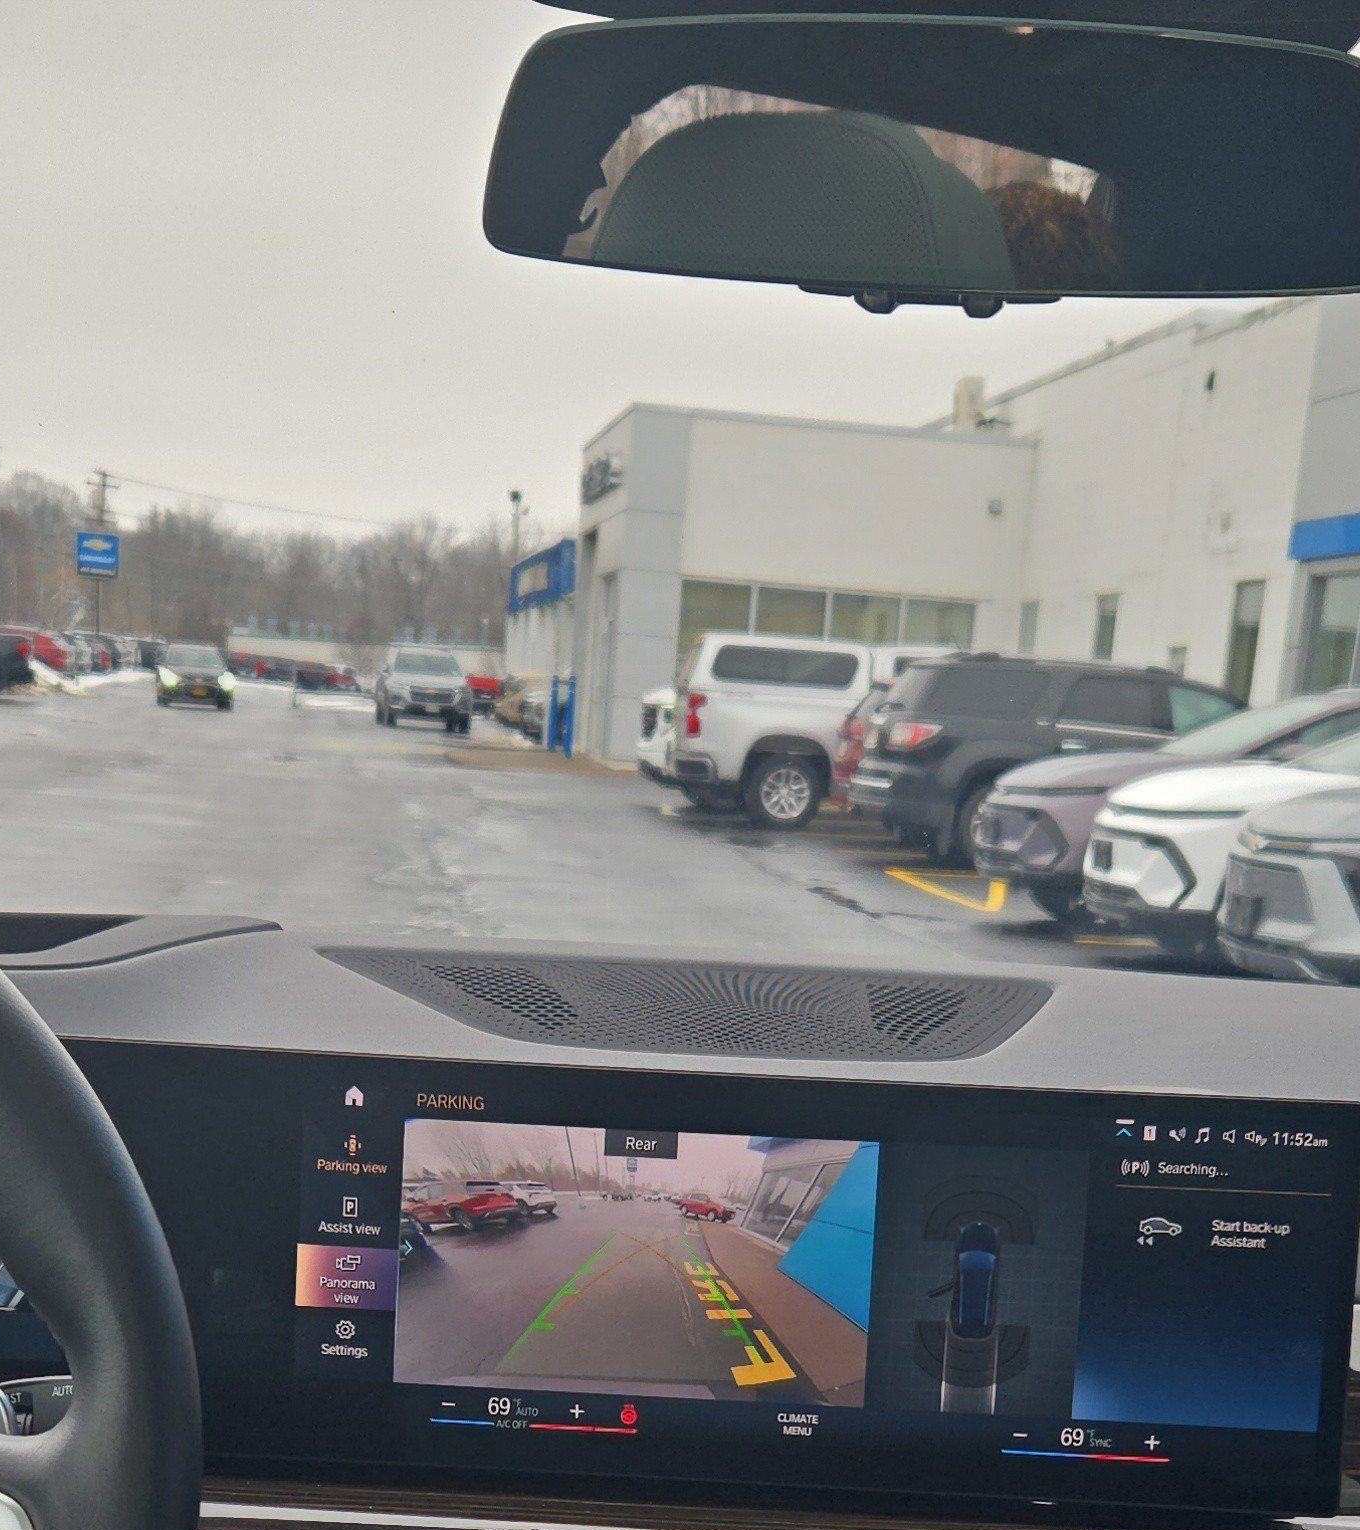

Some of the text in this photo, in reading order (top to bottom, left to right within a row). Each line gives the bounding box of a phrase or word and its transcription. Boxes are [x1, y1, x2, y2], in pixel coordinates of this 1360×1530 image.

[416, 1093, 486, 1111] PARKING
[626, 1136, 658, 1152] Rear
[317, 1158, 388, 1175] Parking view
[1157, 1161, 1229, 1178] Searching...
[318, 1220, 382, 1236] Assist view
[1211, 1219, 1291, 1236] Start back-up
[1210, 1235, 1267, 1250] Assistant
[319, 1276, 376, 1291] Panorama
[334, 1292, 360, 1305] view
[320, 1342, 369, 1359] Settings
[487, 1396, 511, 1416] 69
[515, 1407, 539, 1418] AUTO
[512, 1420, 528, 1430] OFF
[776, 1412, 820, 1425] CLIMATE
[783, 1425, 813, 1437] MENU
[1060, 1427, 1085, 1447] 69
[1089, 1438, 1113, 1449] SYNC
